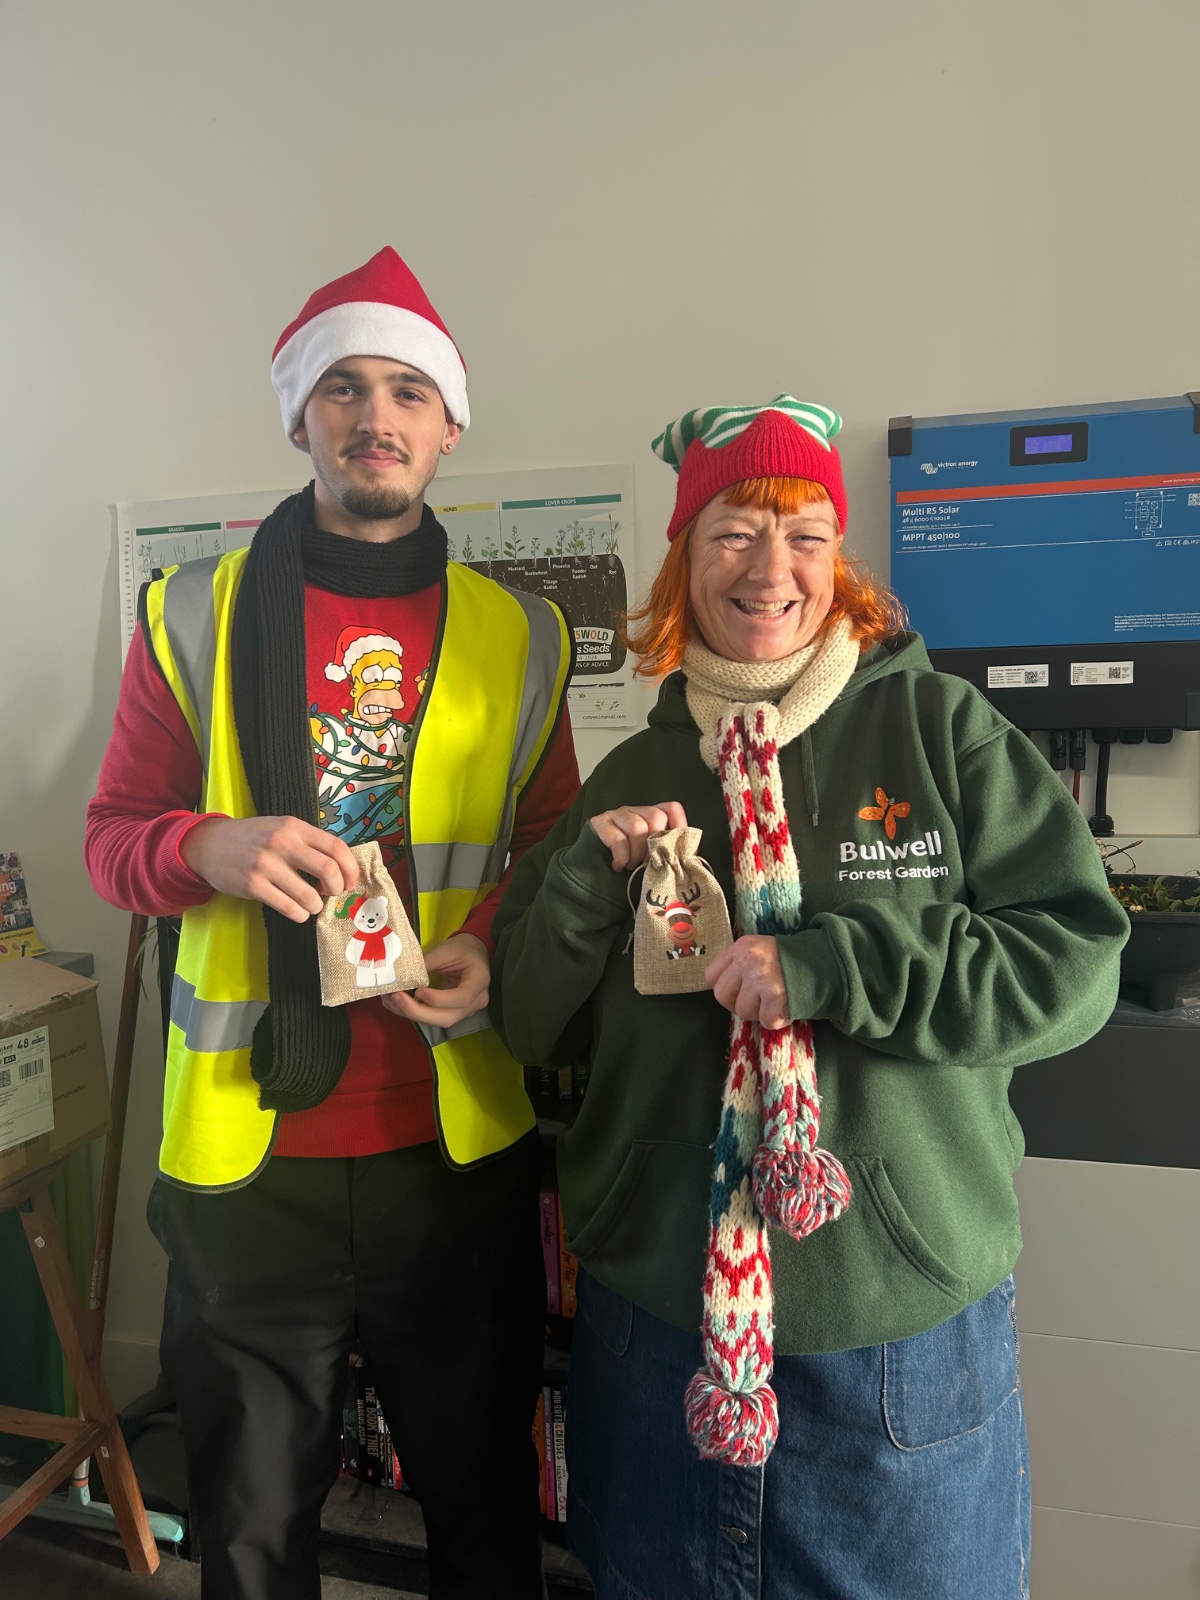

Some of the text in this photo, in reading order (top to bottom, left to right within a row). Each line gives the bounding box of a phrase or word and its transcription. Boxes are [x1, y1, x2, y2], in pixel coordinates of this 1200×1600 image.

[958, 460, 978, 468] energy
[902, 505, 960, 517] Multi RS Solar
[902, 532, 925, 542] MPPT
[575, 629, 609, 641] SWOLD
[583, 643, 610, 653] Seeds
[840, 830, 943, 863] Bulwell
[838, 865, 949, 881] Forest Garden
[17, 1038, 29, 1050] 48
[542, 1209, 555, 1245] Loveless
[564, 1266, 576, 1281] This
[552, 1390, 563, 1423] NOUGHTS
[357, 1399, 366, 1446] MARKUS ZUSAK
[365, 1386, 379, 1458] THE BOOK THIEF
[555, 1429, 565, 1460] CROSSES
